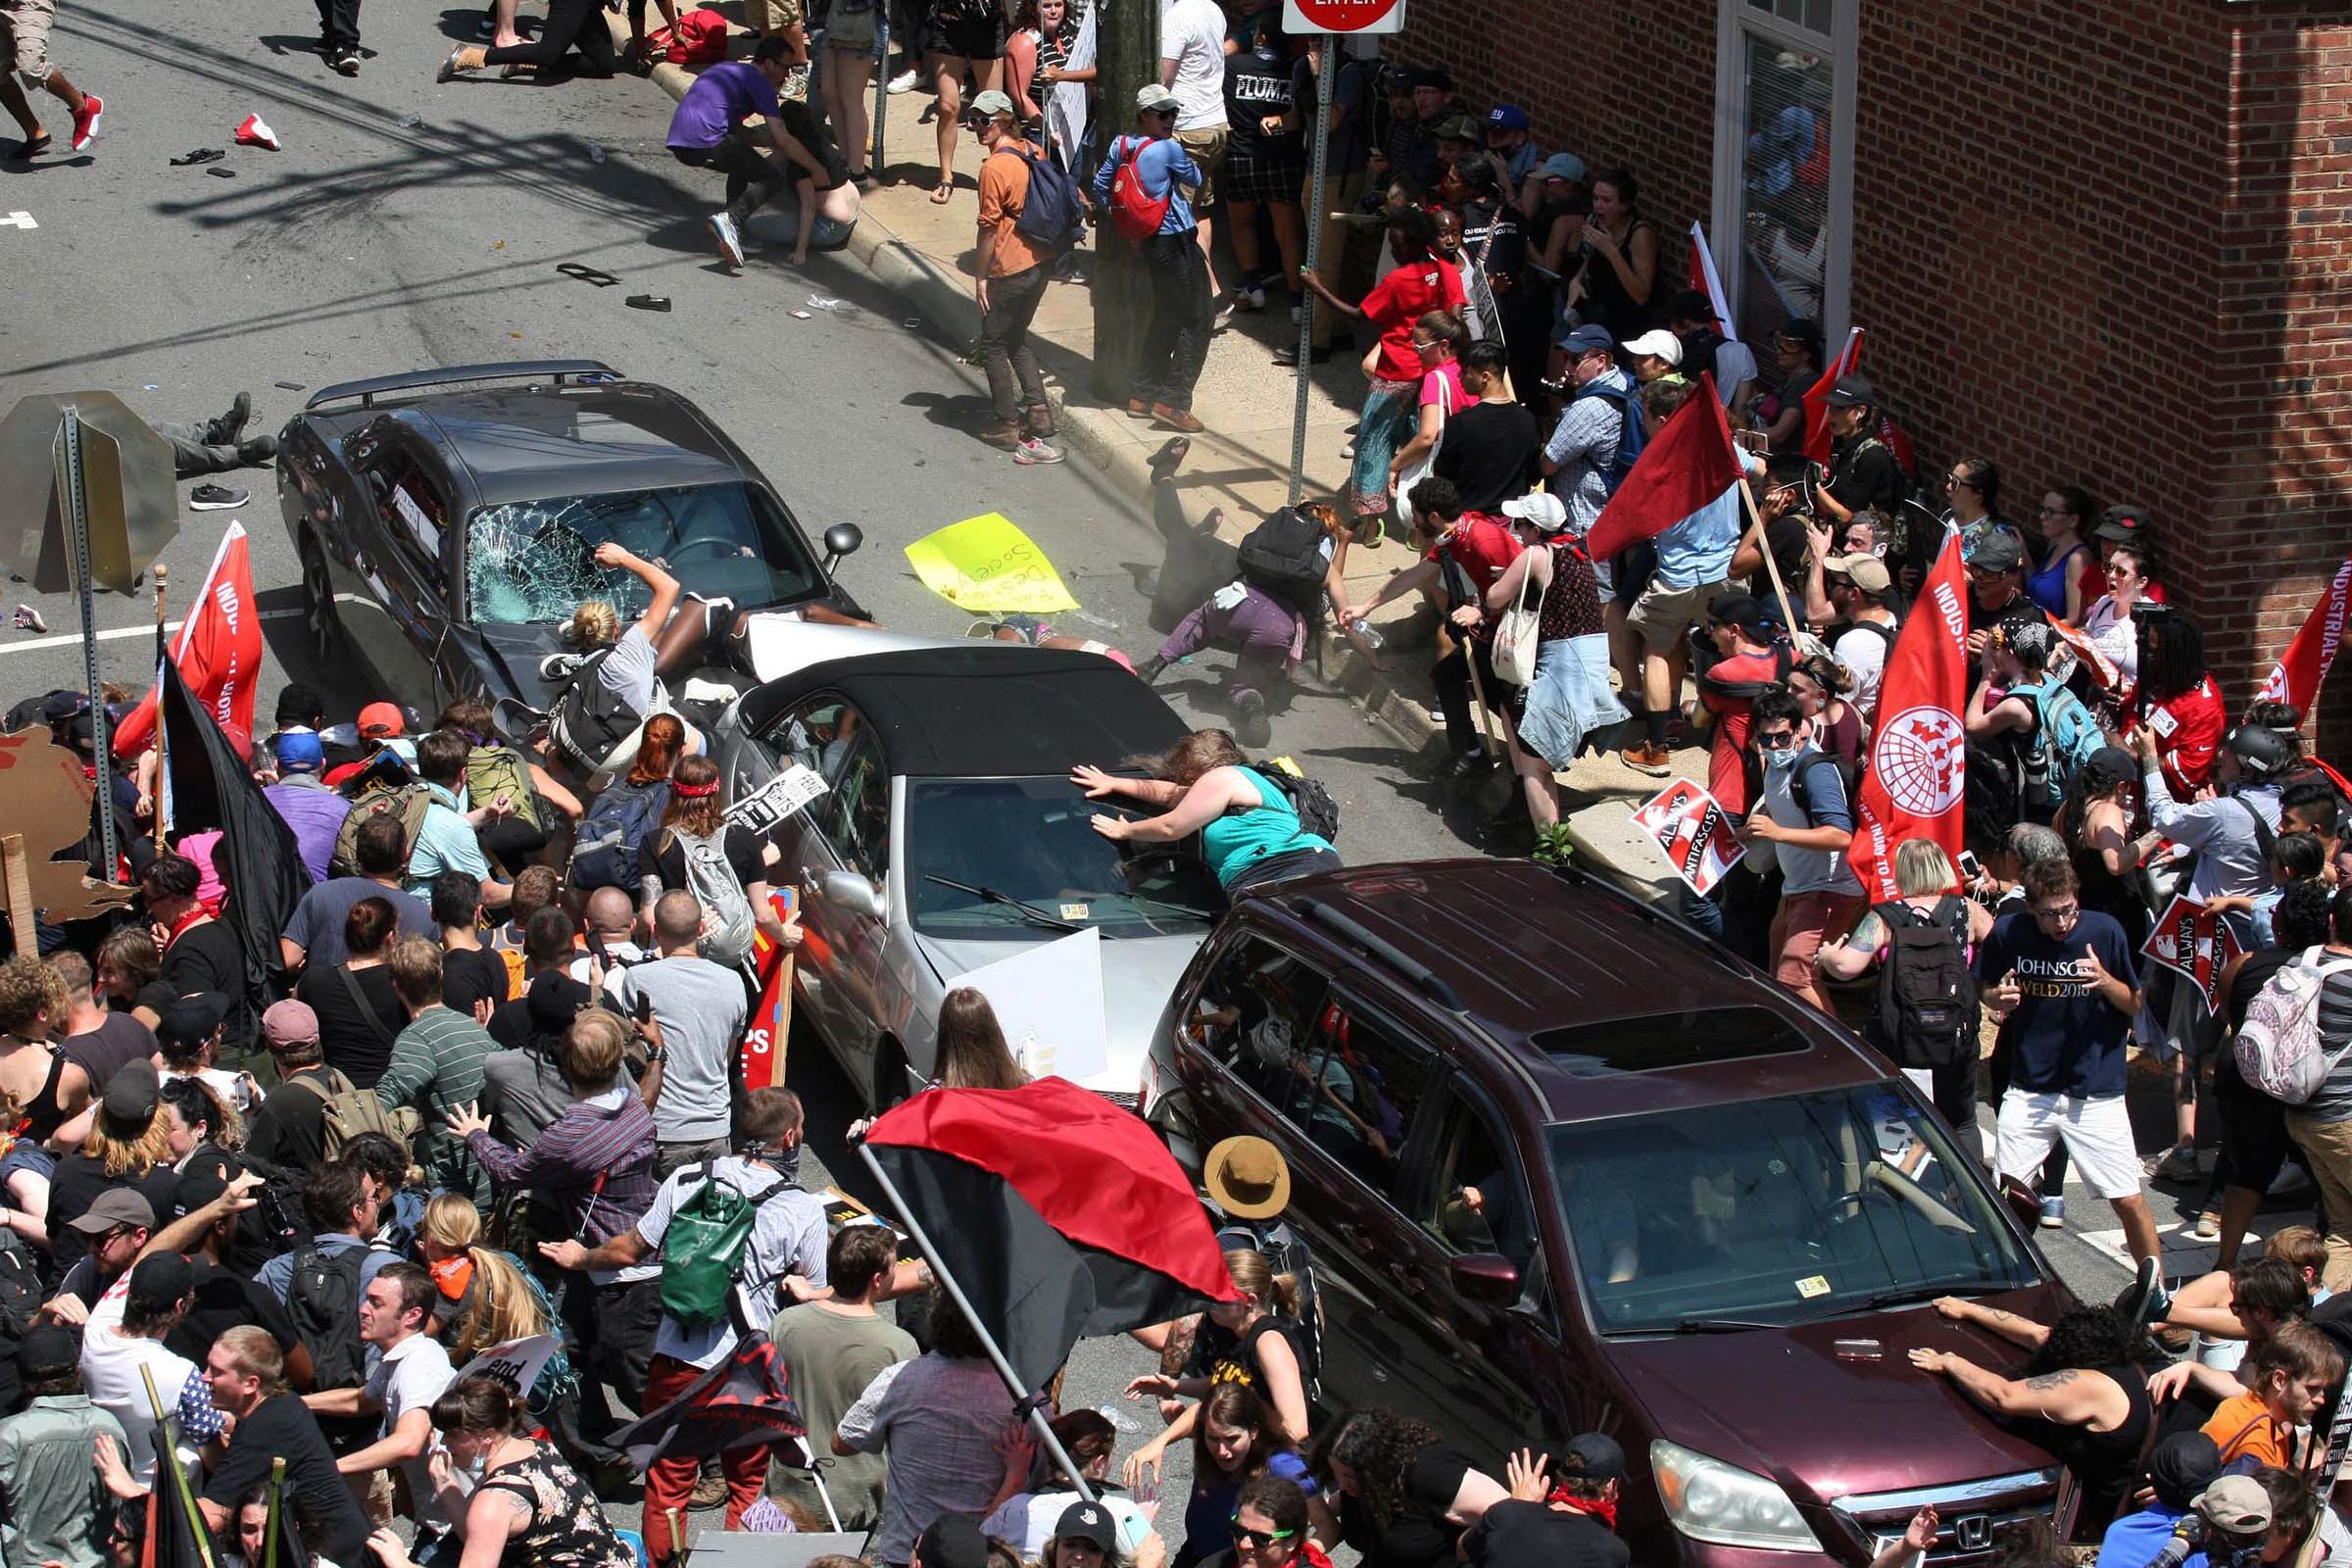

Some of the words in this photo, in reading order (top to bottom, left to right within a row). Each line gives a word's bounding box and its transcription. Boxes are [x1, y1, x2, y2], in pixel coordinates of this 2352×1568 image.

[1684, 805, 1719, 881] ANTIFASCIST
[1877, 859, 1889, 876] TO
[1881, 878, 1898, 900] ALL
[2179, 917, 2194, 971] ALWAYS
[2207, 920, 2227, 1001] ANTIFASCIST
